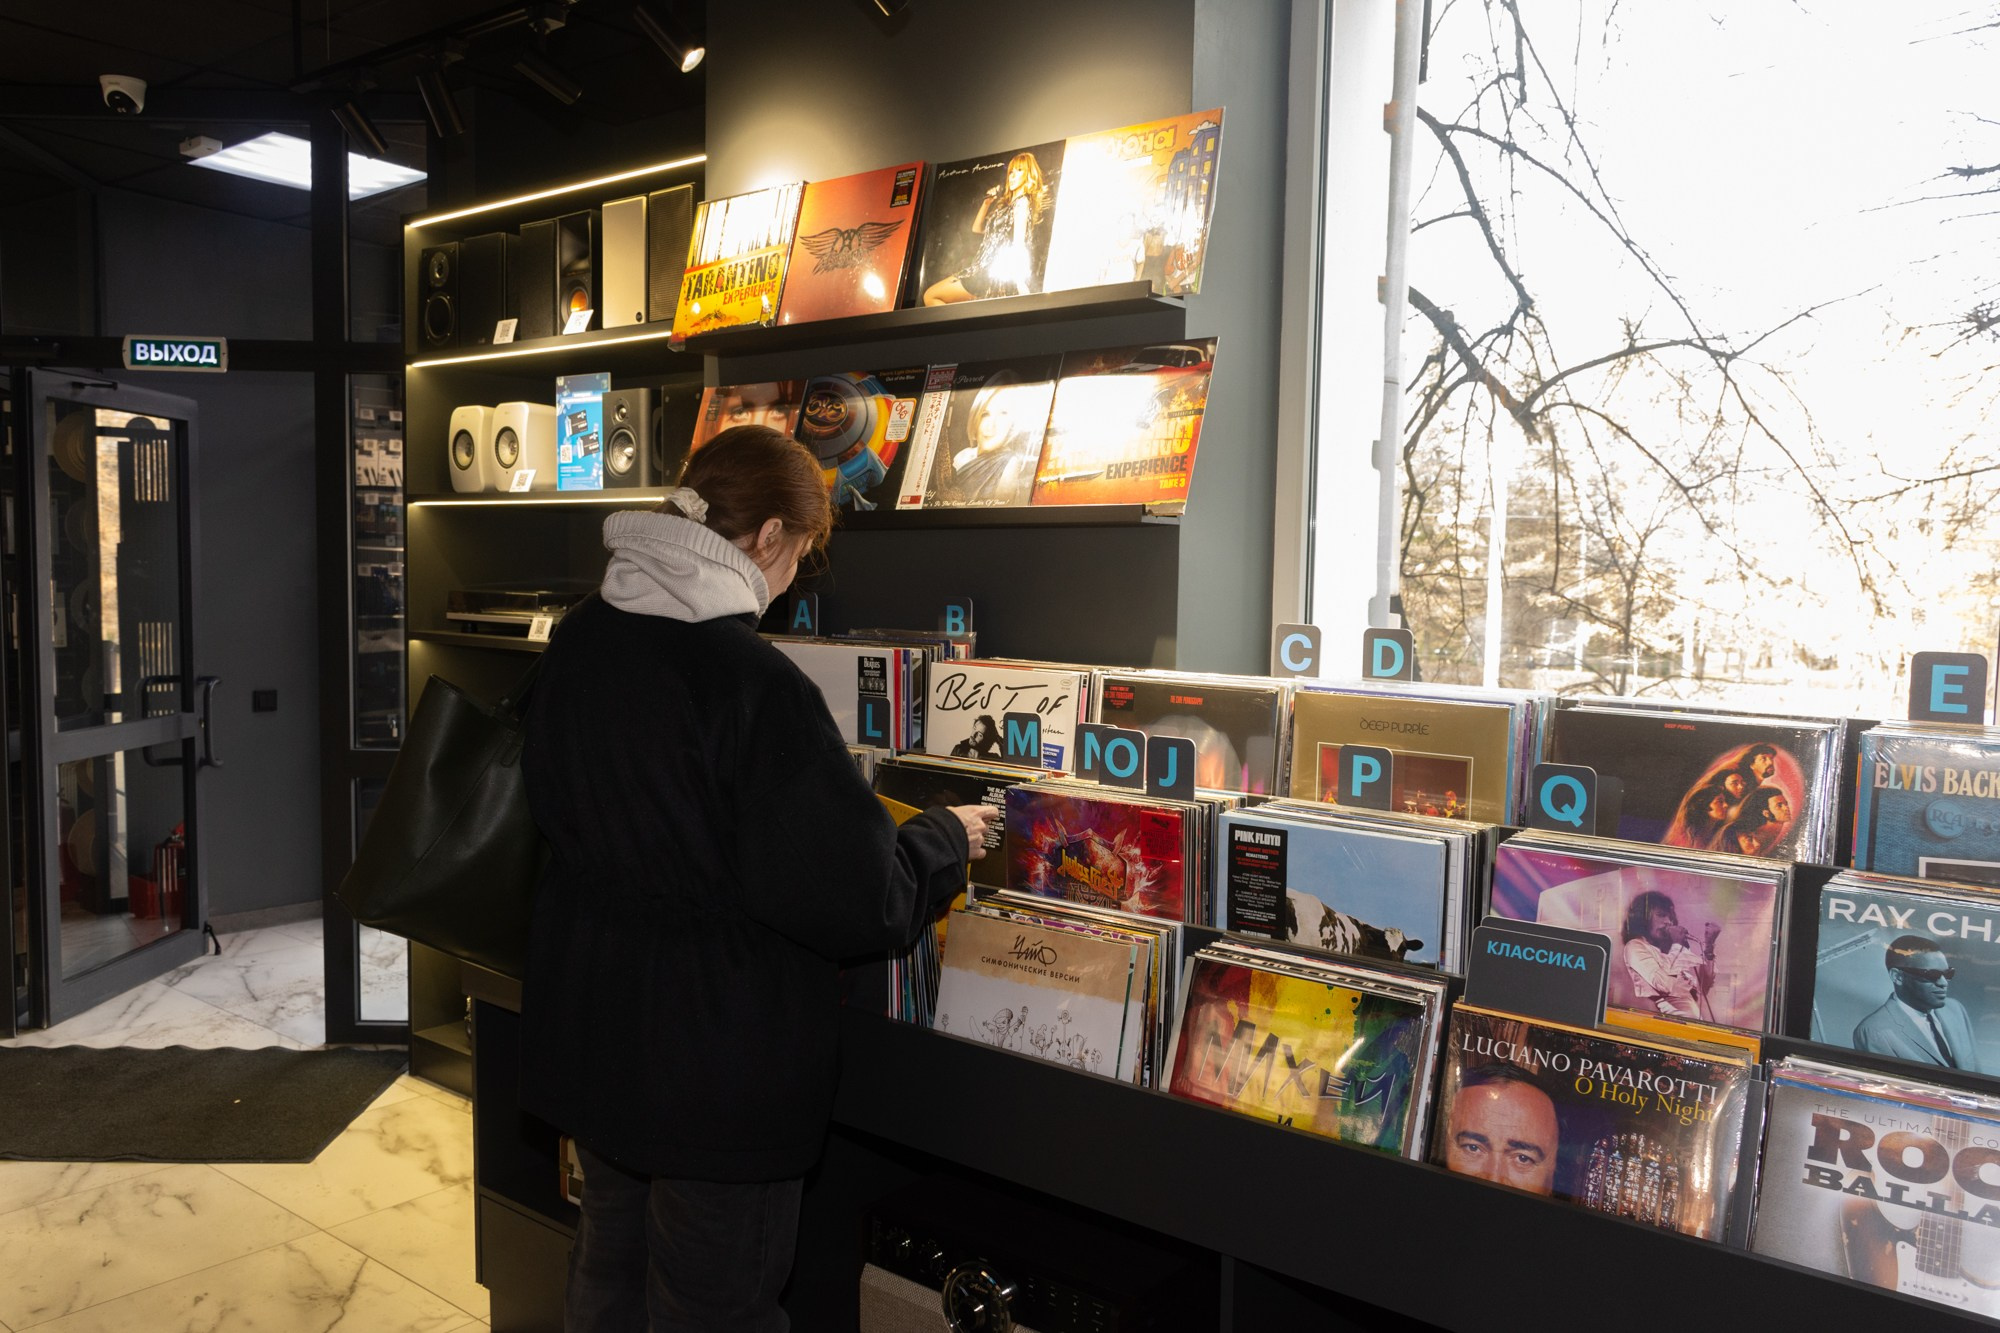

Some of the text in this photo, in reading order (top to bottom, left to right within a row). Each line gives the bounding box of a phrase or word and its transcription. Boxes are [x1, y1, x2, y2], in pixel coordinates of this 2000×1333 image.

[685, 252, 781, 301] TARANTINO
[723, 280, 777, 305] EXPERIENCE
[135, 343, 217, 364] ВЫХОД
[1105, 455, 1188, 480] EXPERIENCE
[1159, 478, 1186, 490] TAKE 3
[793, 600, 812, 630] A
[946, 605, 965, 637] B
[1280, 633, 1312, 672] C
[1372, 638, 1404, 677] D
[936, 673, 1069, 715] BEST OF
[1929, 664, 1969, 714] E
[866, 703, 882, 738] L
[1007, 719, 1038, 758] M
[1360, 717, 1430, 736] DEEP PURPLE
[1104, 737, 1139, 778] O
[1158, 746, 1178, 787] J
[1351, 754, 1382, 797] P
[1873, 761, 1937, 793] ELVIS
[1540, 774, 1587, 828] Q
[1234, 829, 1281, 846] PINK FLOYD
[1828, 897, 2000, 943] RAY CH
[981, 956, 1080, 983] СИМФОНИЧЕСКИЕ ВЕРСИИ
[1486, 940, 1586, 971] КЛАССИКА
[1197, 1019, 1396, 1124] МИХЕЙ
[1462, 1033, 1718, 1105] LUCIANO PAVAROTTI
[1574, 1075, 1714, 1126] O Holy Night
[1814, 1103, 1850, 1119] THE
[1864, 1113, 1957, 1141] ULTIMATE
[1807, 1112, 2000, 1201] ROC
